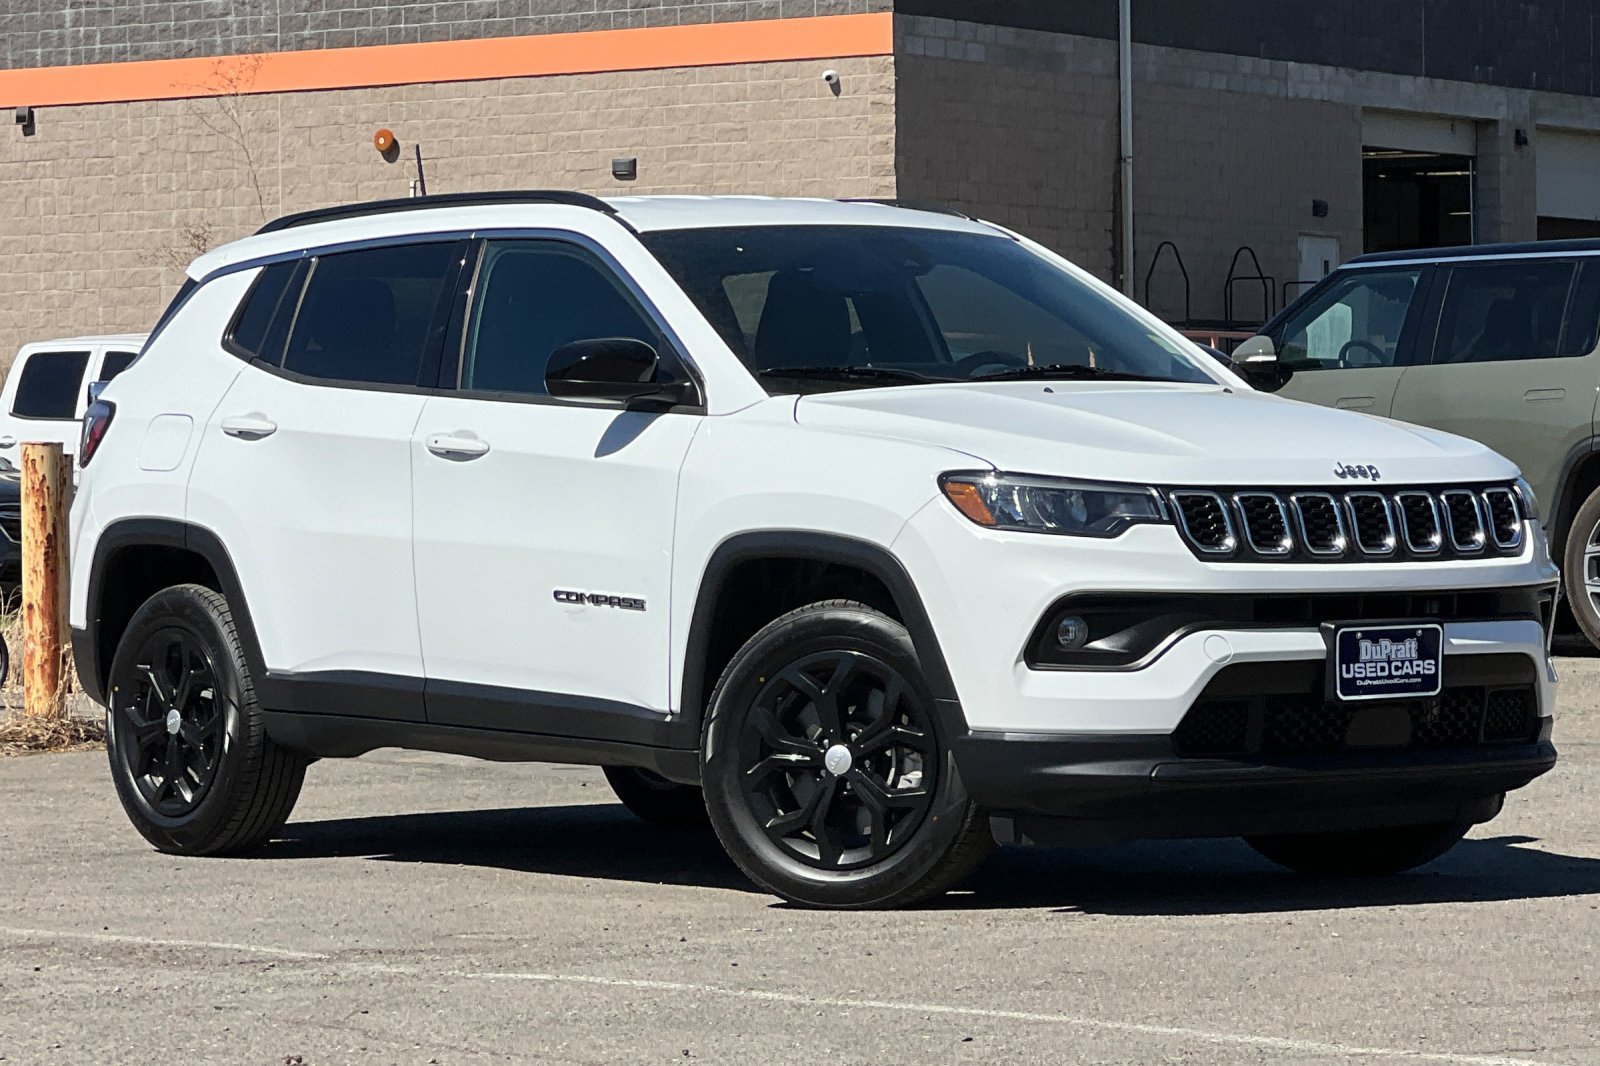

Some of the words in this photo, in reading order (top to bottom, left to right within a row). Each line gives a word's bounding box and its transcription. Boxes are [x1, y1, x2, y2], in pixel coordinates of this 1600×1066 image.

[1334, 461, 1381, 481] Jeep
[553, 590, 646, 611] COMPASS
[1359, 638, 1418, 661] DuPratt
[1342, 662, 1389, 678] USED
[1391, 660, 1436, 676] CARS
